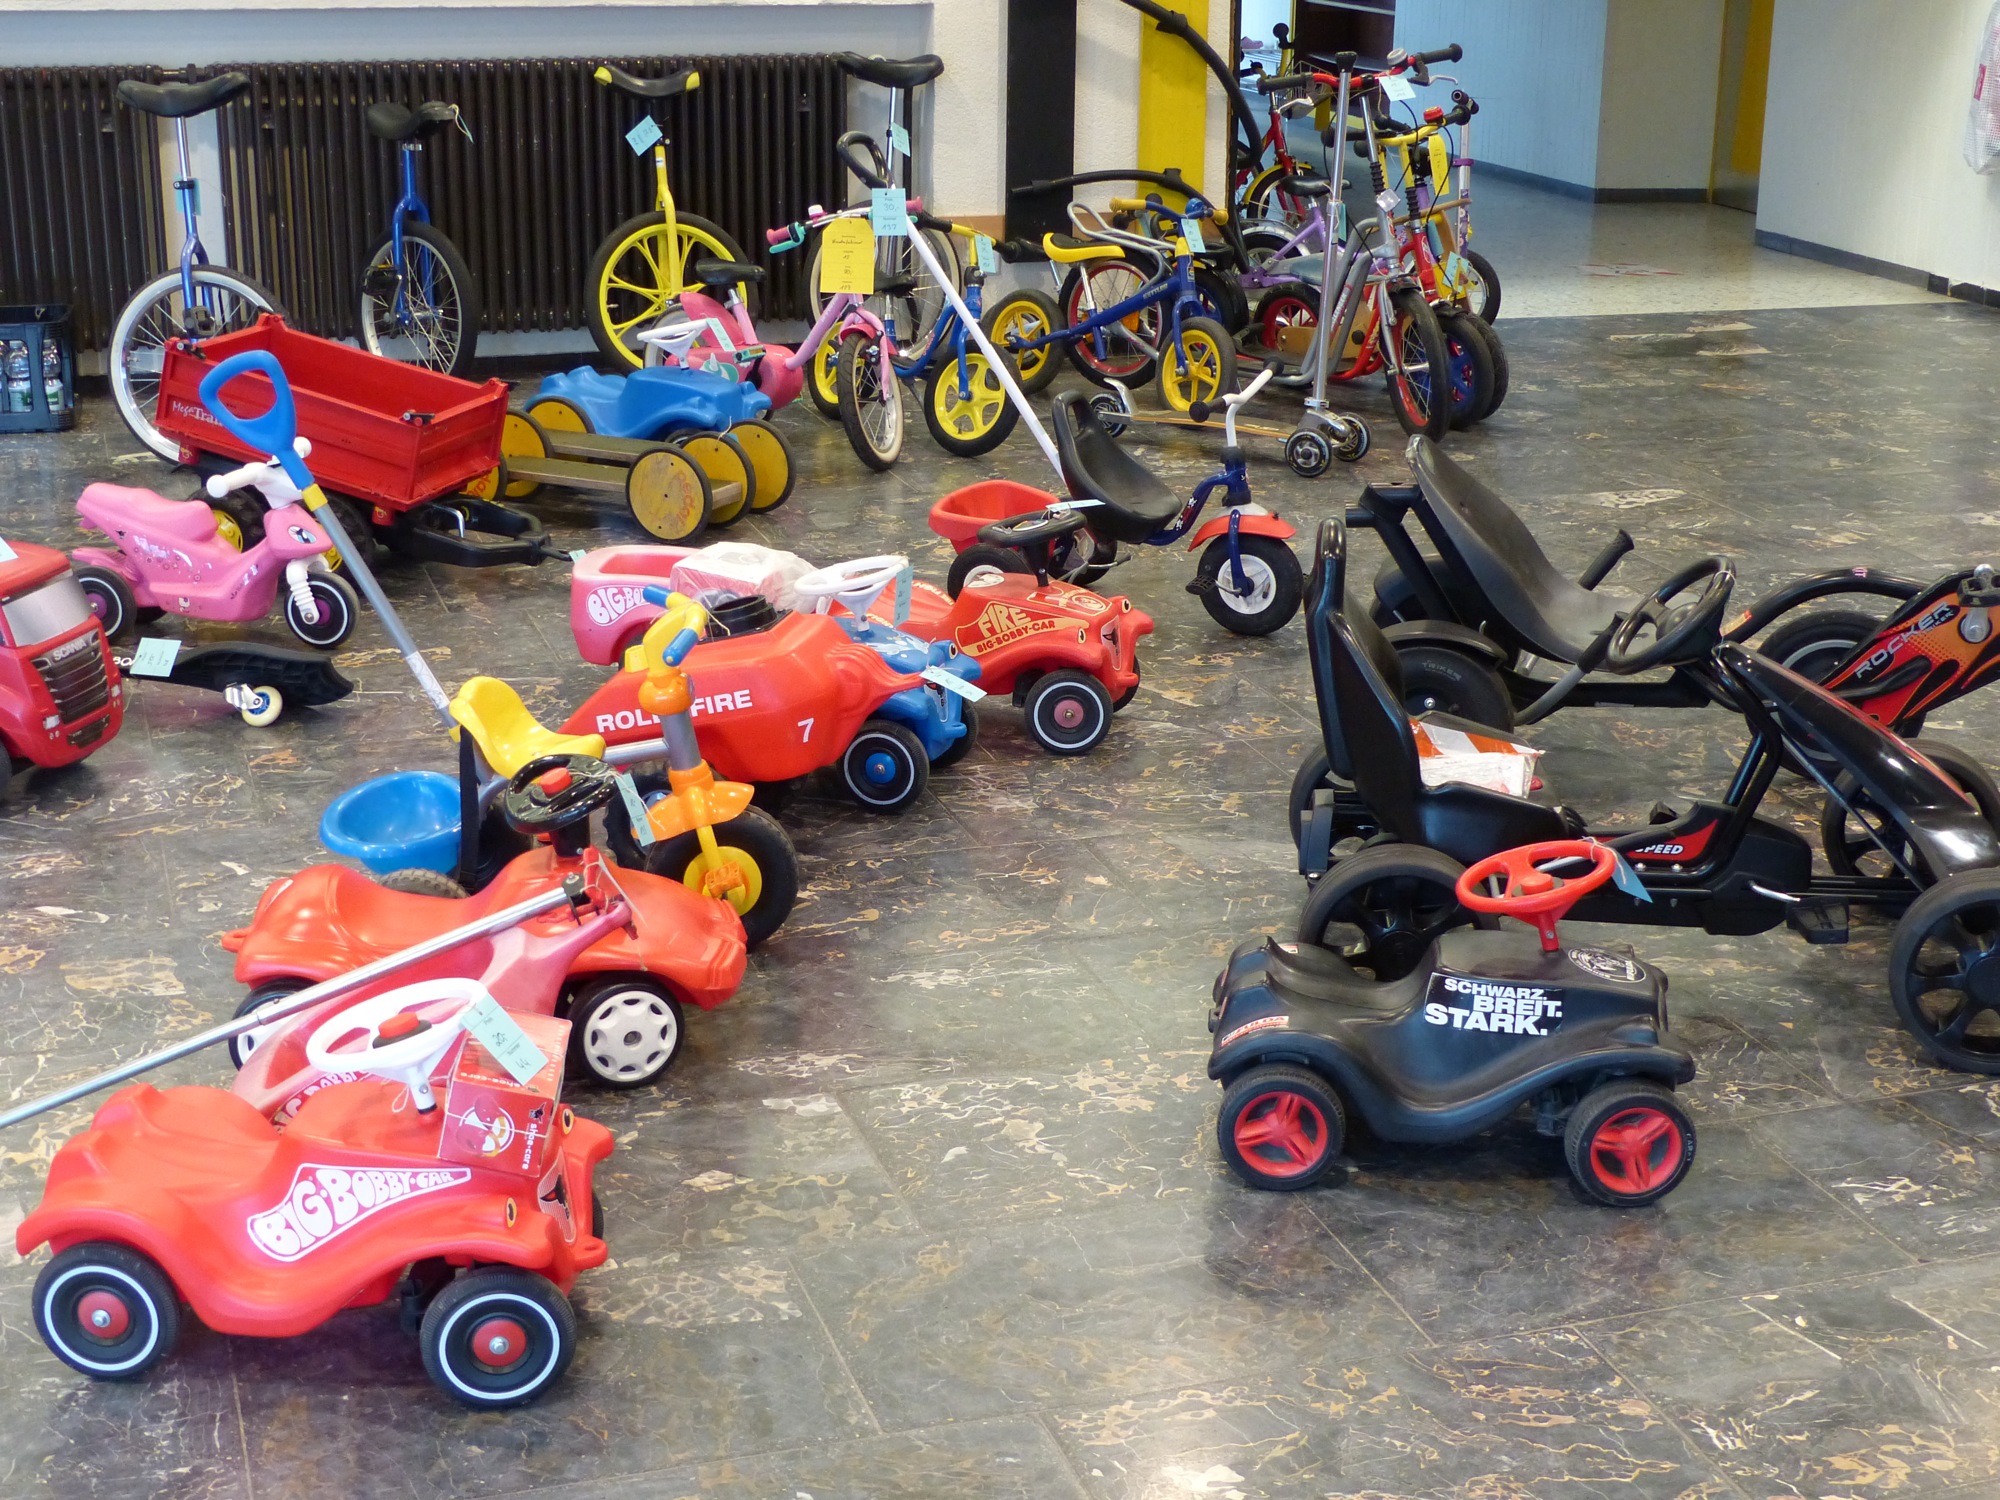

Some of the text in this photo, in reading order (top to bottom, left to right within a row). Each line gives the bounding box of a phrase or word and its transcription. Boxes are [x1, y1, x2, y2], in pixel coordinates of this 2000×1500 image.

[978, 604, 1032, 639] FIRE
[52, 638, 87, 662] SCANIA
[1854, 601, 1951, 679] ROCKER
[689, 689, 753, 718] FIRE
[797, 717, 815, 743] 7
[1444, 978, 1548, 1001] SCHWARZ.
[1424, 1002, 1548, 1036] STARK.
[1473, 994, 1563, 1018] BREIT.
